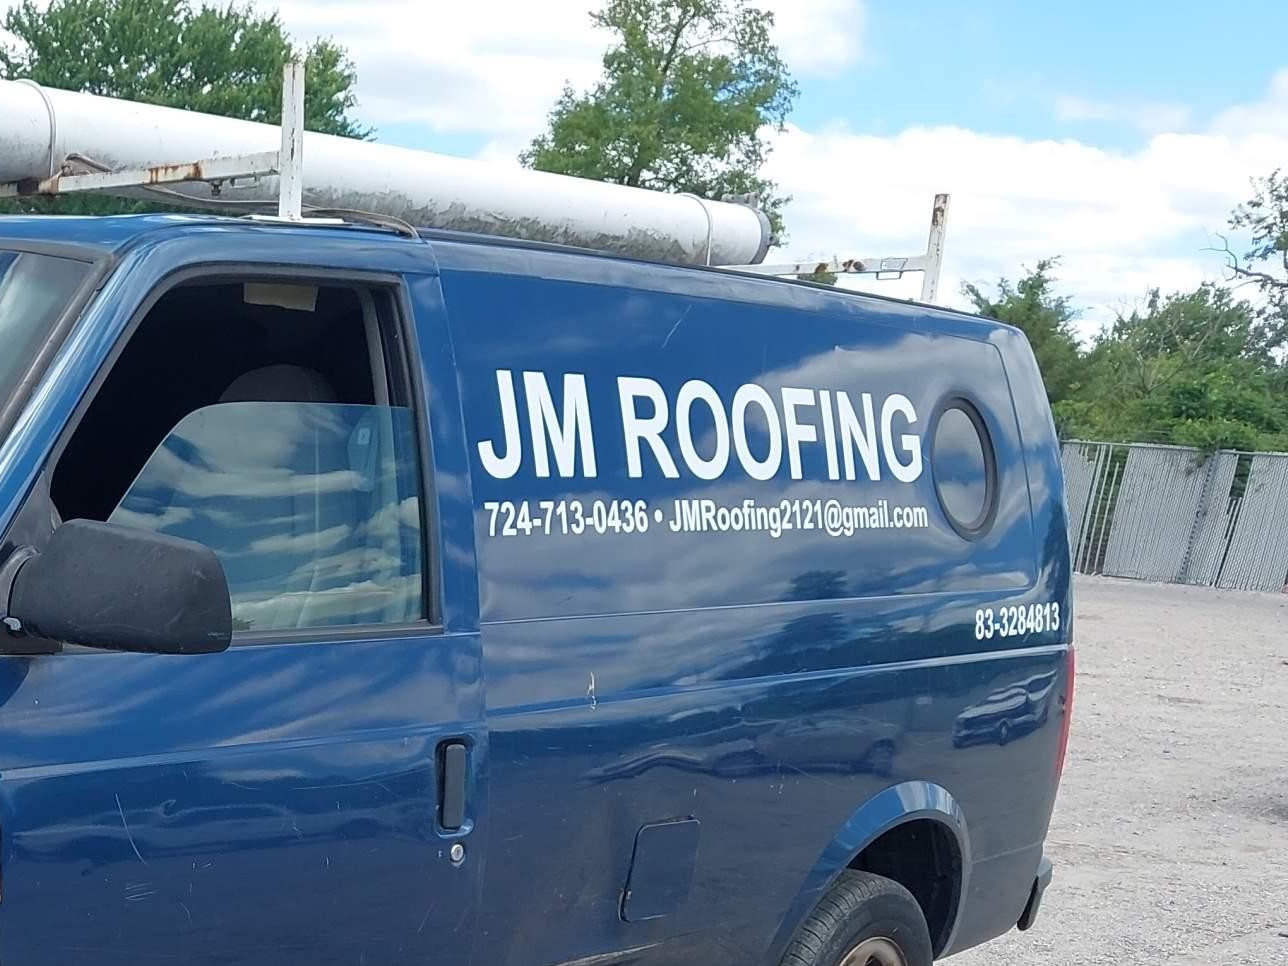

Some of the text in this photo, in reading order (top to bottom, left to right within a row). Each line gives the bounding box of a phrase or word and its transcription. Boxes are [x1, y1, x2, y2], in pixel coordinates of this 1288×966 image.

[477, 369, 925, 483] JM ROOFING
[484, 501, 648, 537] 724-713-0436
[669, 499, 928, 538] JMRoofing2121@gmail.com
[974, 602, 1060, 641] 83-3284813
